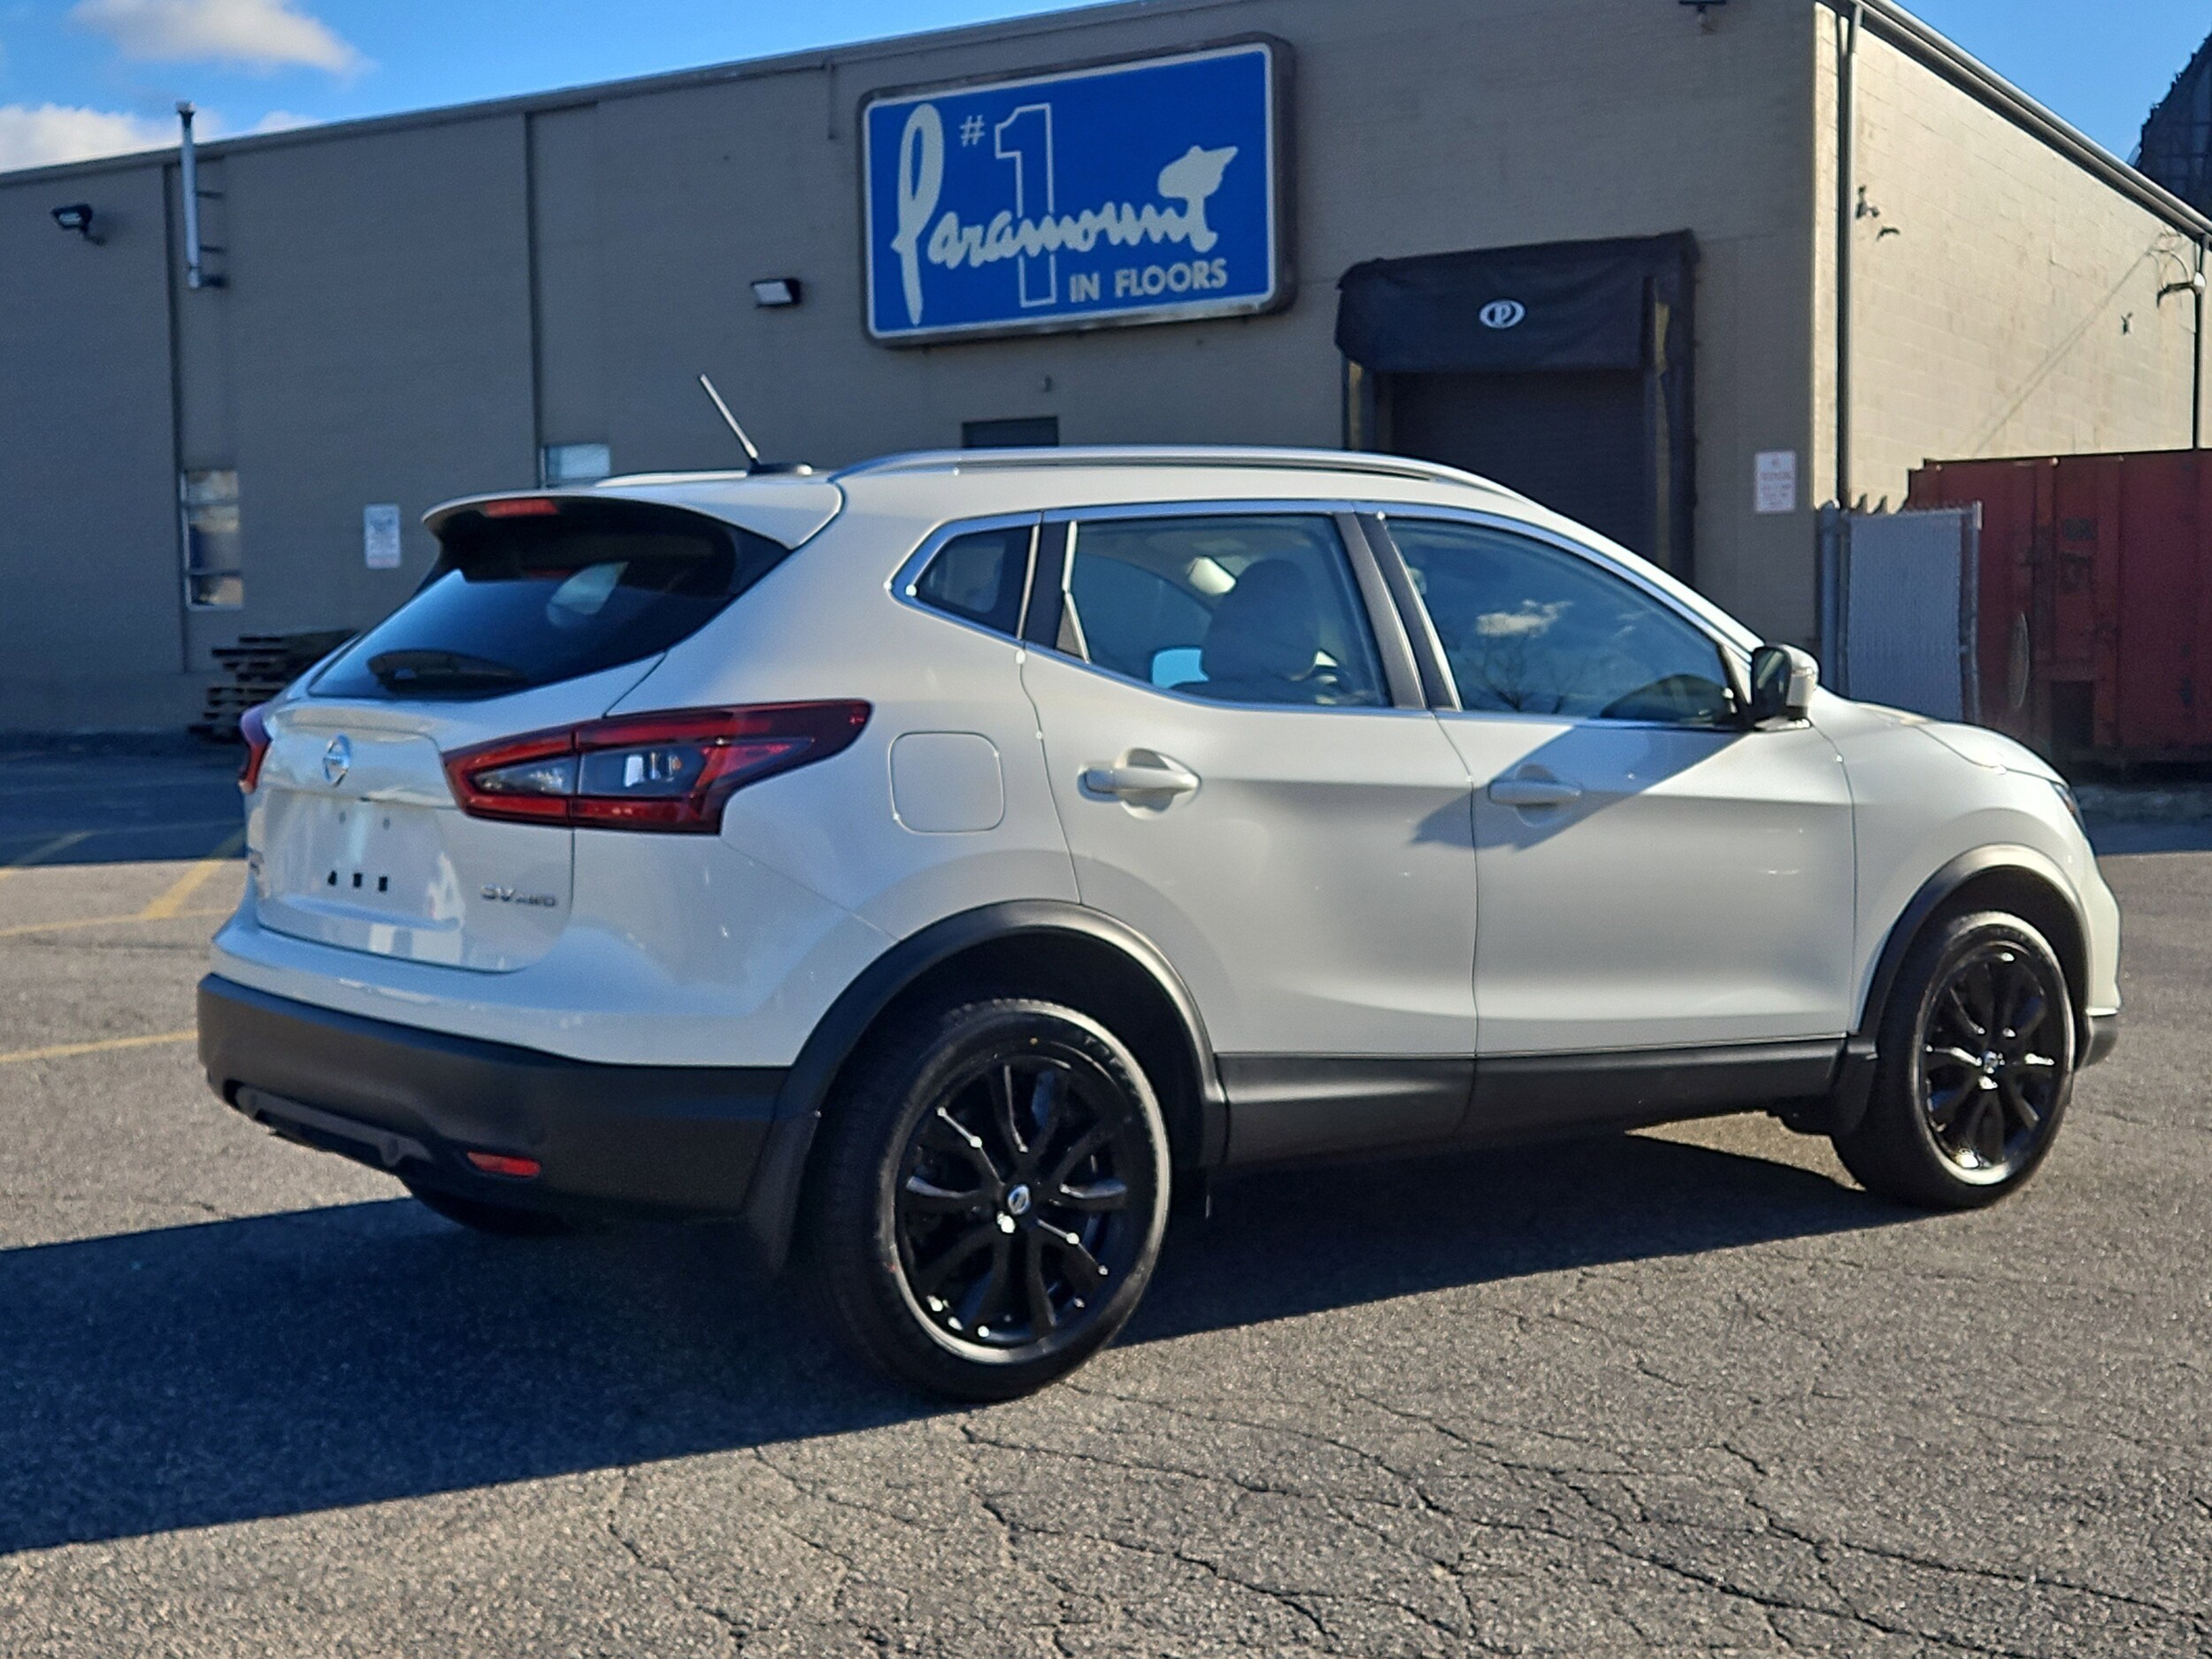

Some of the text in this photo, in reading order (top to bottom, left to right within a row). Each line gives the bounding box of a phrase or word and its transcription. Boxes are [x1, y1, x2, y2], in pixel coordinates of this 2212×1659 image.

[890, 102, 1238, 327] Paramount
[1069, 257, 1228, 303] IN FLOORS
